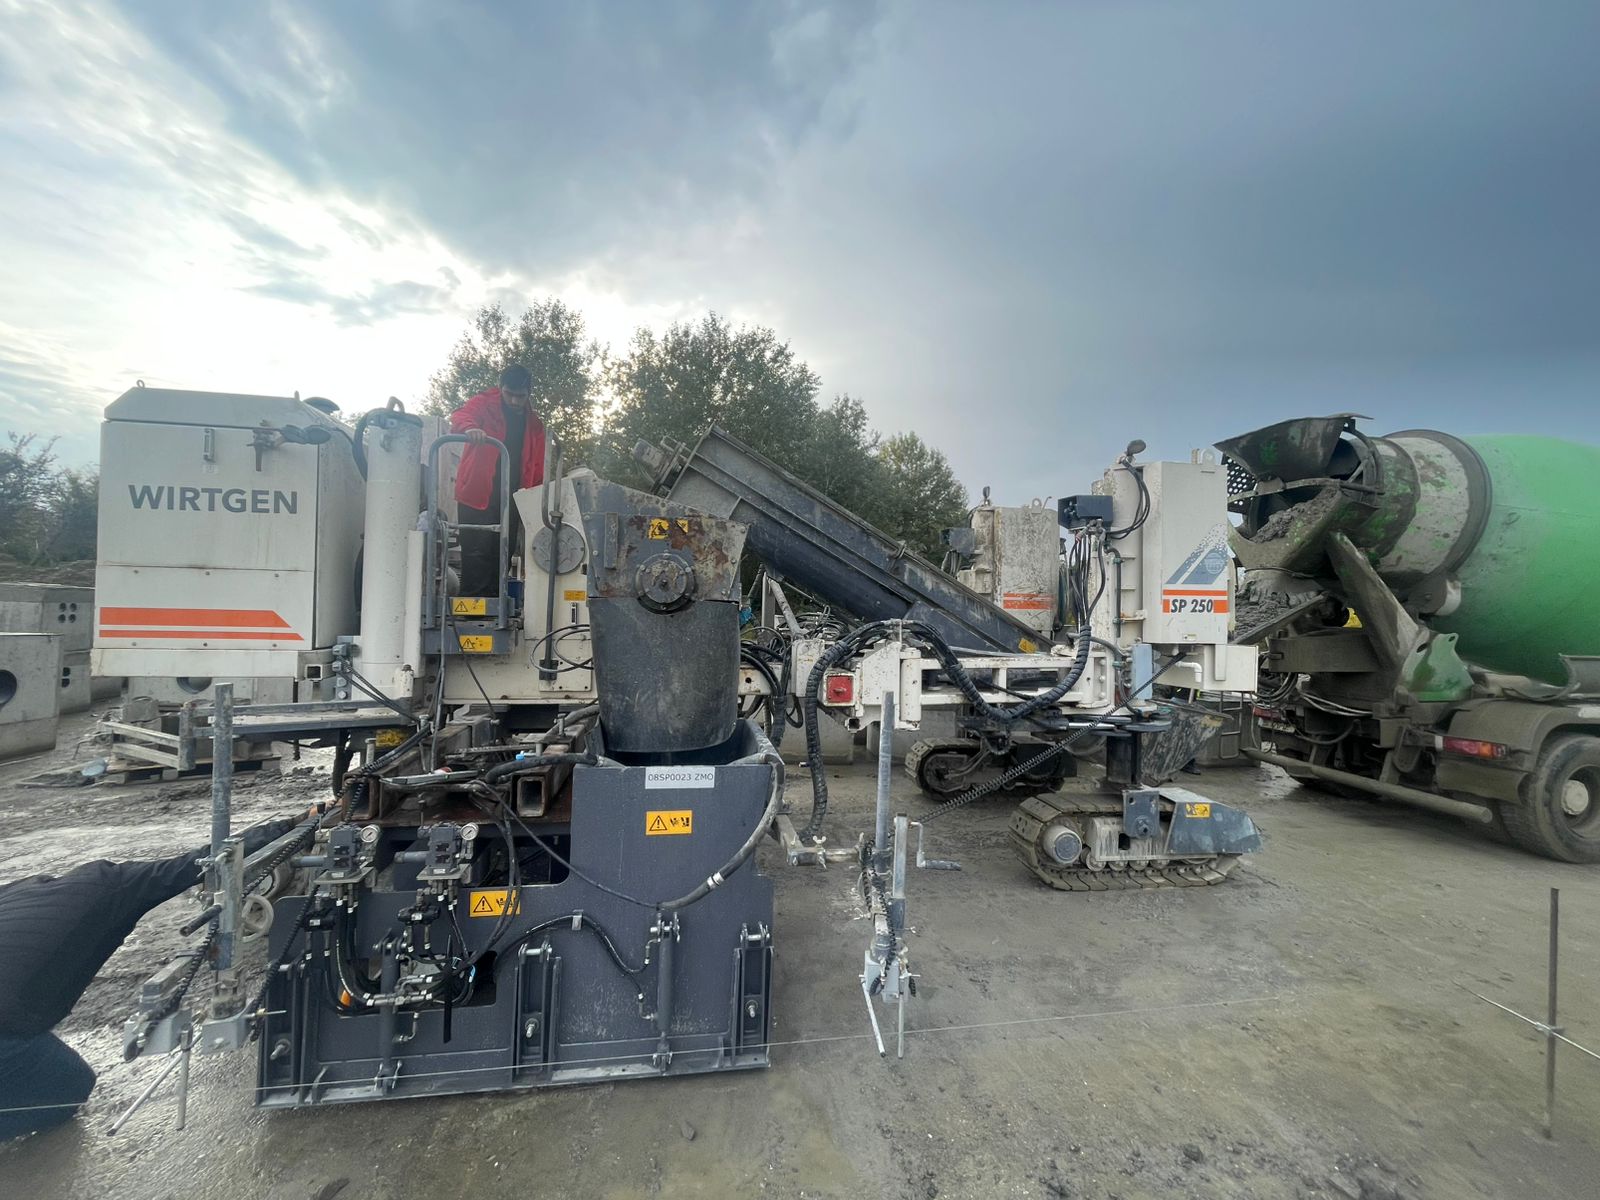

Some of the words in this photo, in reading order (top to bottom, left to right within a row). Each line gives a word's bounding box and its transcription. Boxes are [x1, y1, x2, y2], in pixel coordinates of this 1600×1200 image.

[128, 484, 298, 514] WIRTGEN
[1171, 598, 1187, 613] SP
[1190, 598, 1213, 613] 250
[647, 773, 692, 781] 08SP0023
[694, 772, 714, 781] ZMO
